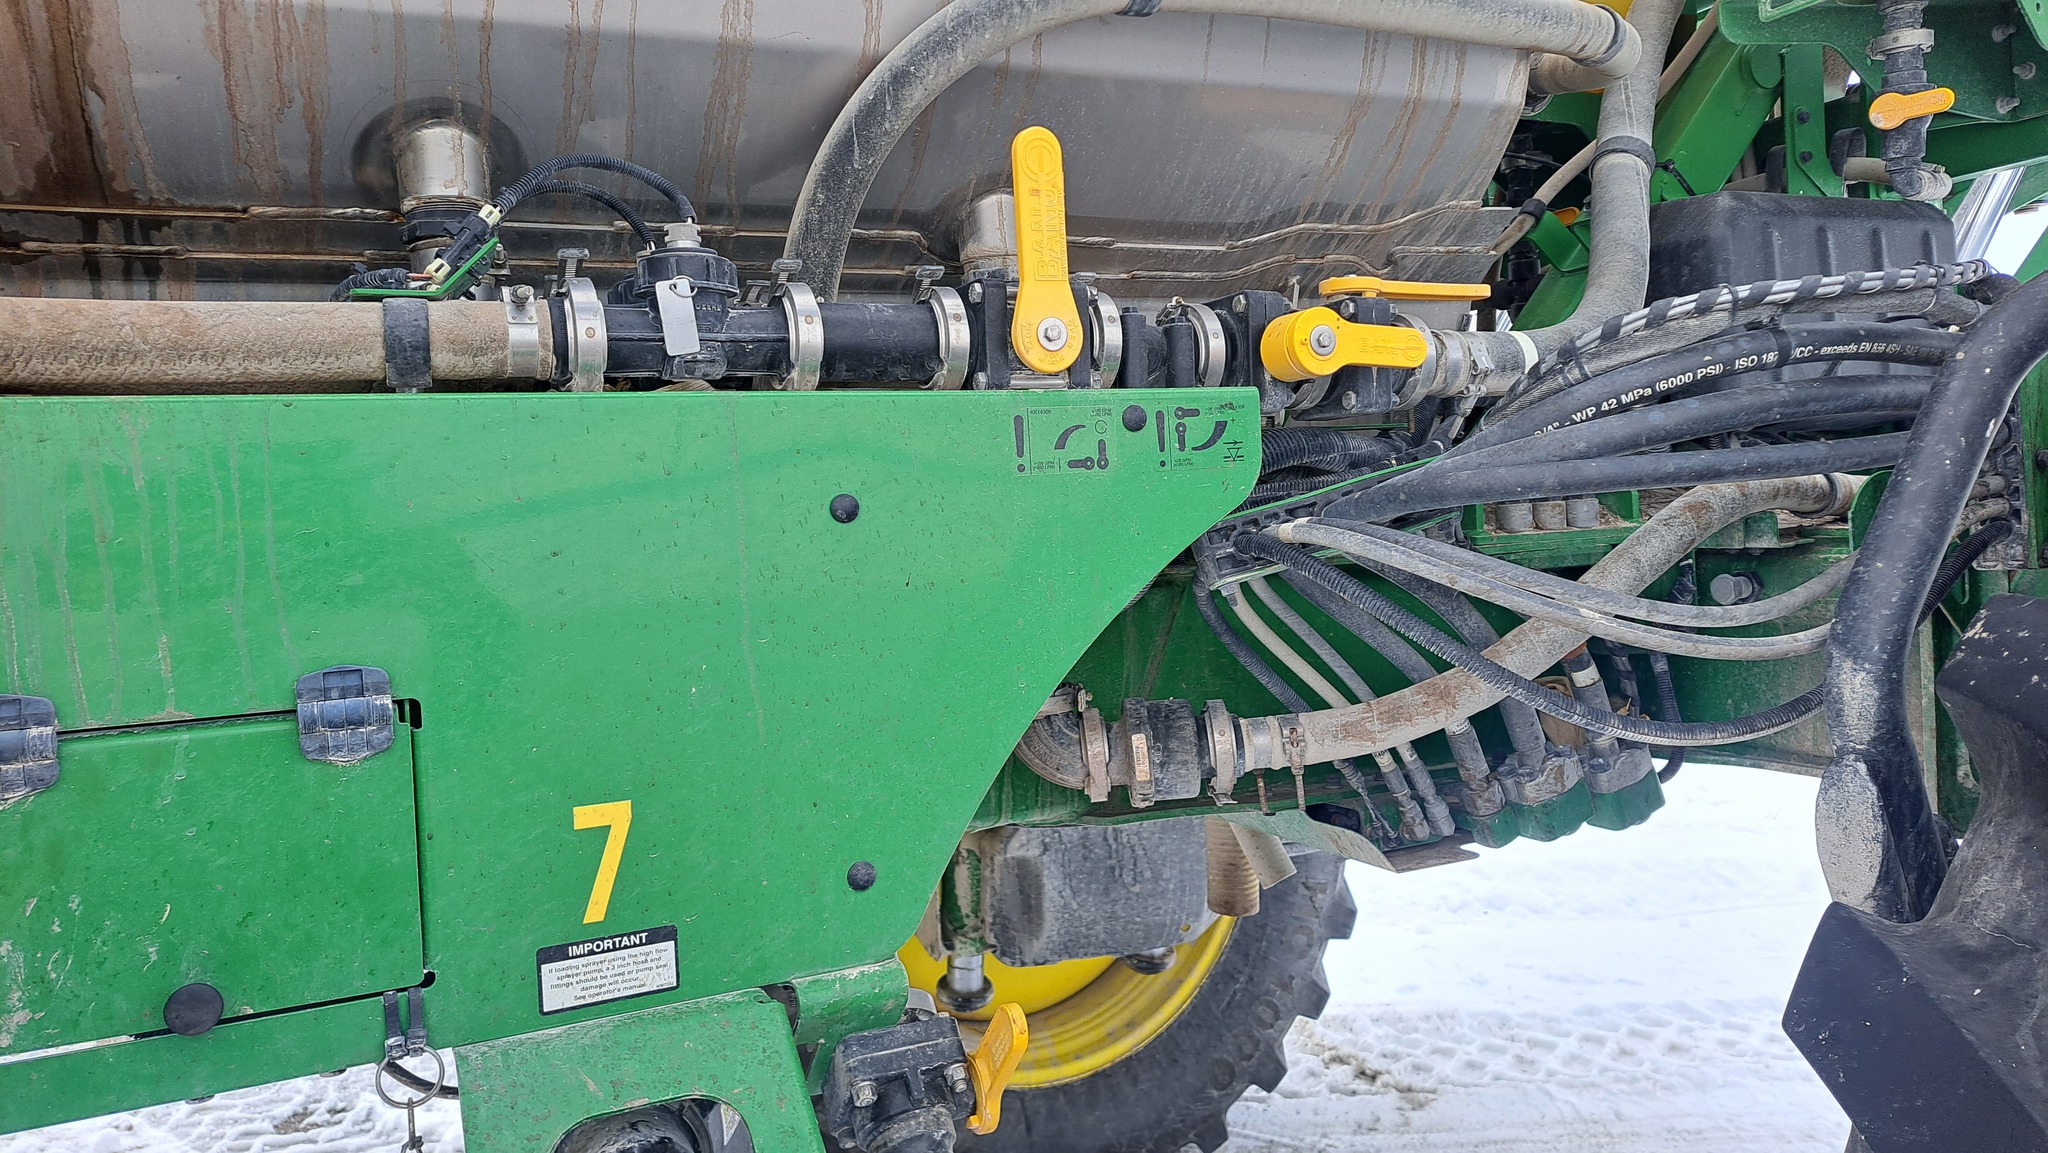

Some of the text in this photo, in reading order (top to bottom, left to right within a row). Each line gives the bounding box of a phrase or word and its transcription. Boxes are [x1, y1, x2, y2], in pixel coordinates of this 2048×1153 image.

[1571, 406, 1597, 422] WP
[1601, 400, 1619, 412] 42
[1621, 387, 1652, 404] MPa
[1655, 373, 1694, 392] (6000
[1697, 363, 1724, 380] PSI)
[1734, 355, 1758, 371] ISO
[1820, 342, 1858, 355] exceeds
[1858, 342, 1872, 353] EN
[573, 799, 632, 925] 7
[568, 933, 648, 956] IMPORTANT
[555, 964, 579, 973] loading
[582, 959, 606, 969] sprayer
[608, 954, 626, 964] using
[639, 950, 654, 958] high
[556, 972, 582, 981] sprayer
[633, 958, 648, 966] hose
[550, 981, 573, 990] fittings
[576, 976, 598, 985] should
[636, 967, 654, 975] pump
[580, 983, 606, 992] damage
[588, 987, 620, 998] operator's
